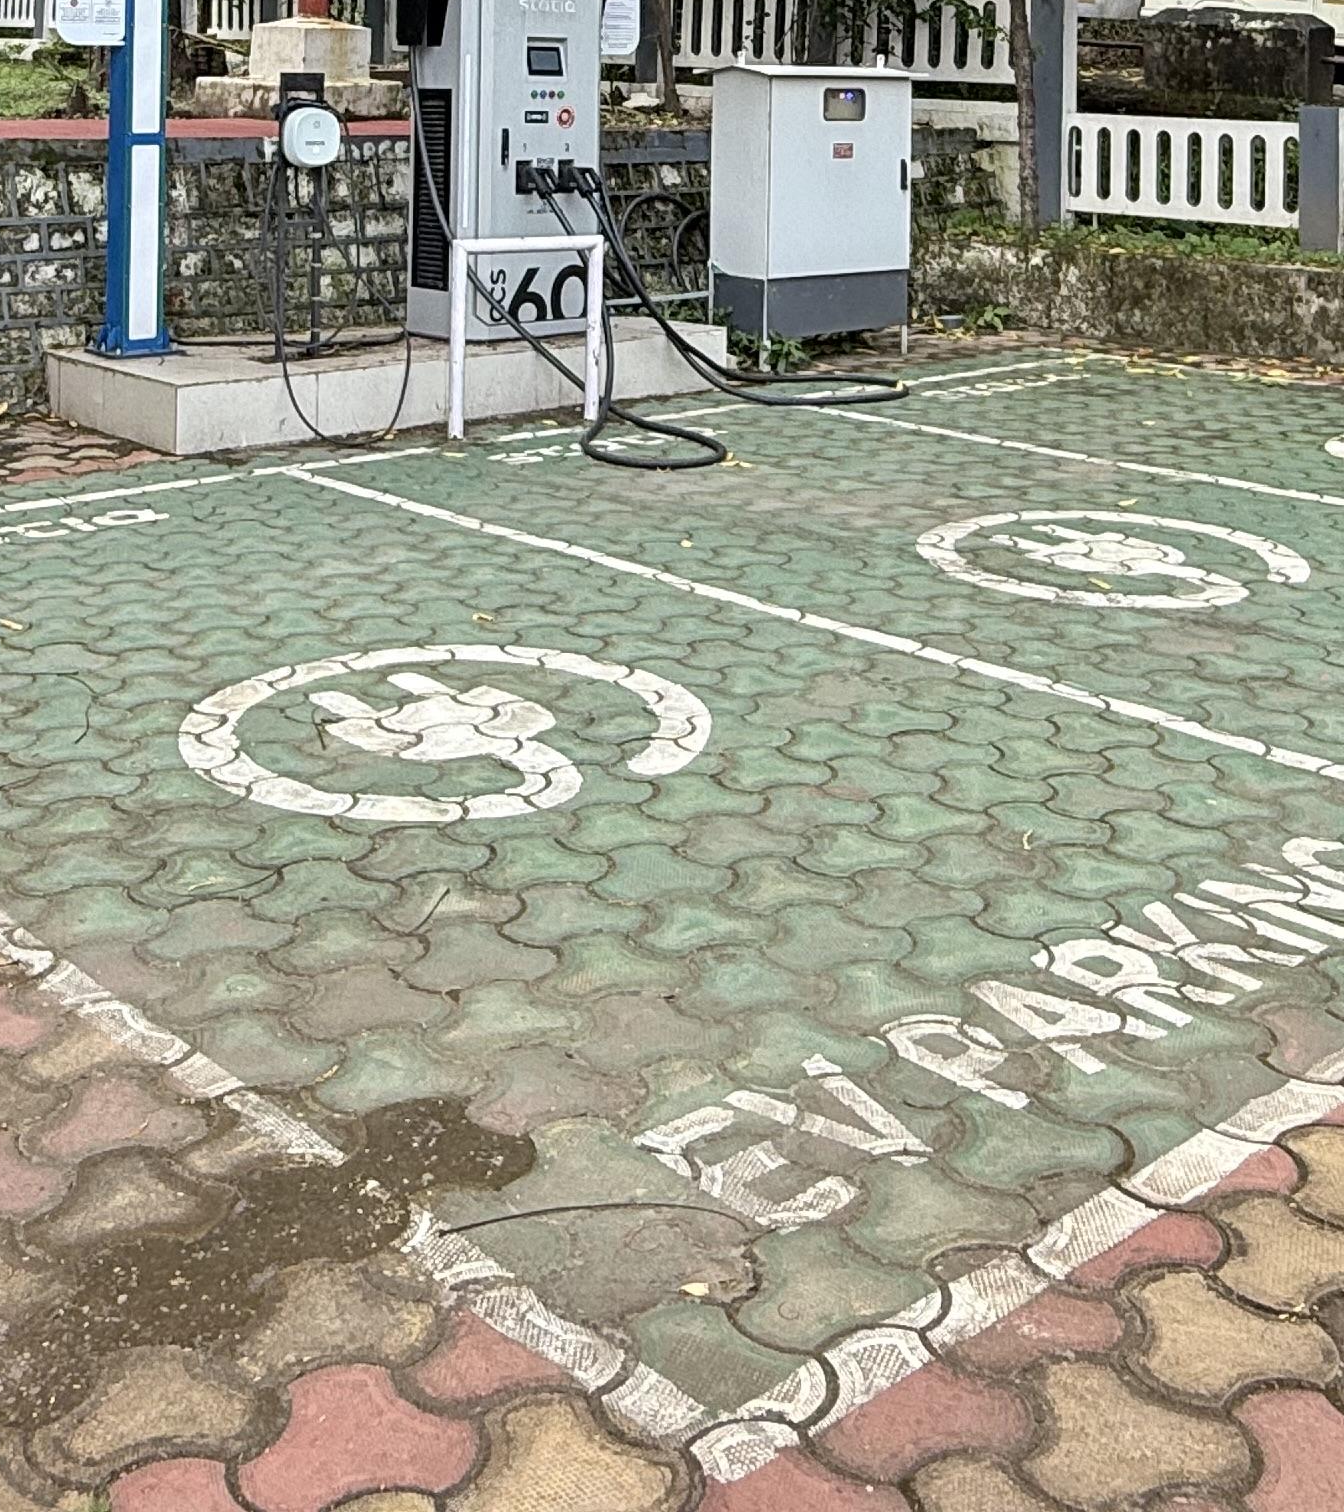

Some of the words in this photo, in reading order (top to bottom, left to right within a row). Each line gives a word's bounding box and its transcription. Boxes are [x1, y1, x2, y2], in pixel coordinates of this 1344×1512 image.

[490, 268, 506, 323] CCS
[507, 264, 589, 322] 60
[634, 1053, 934, 1234] EV
